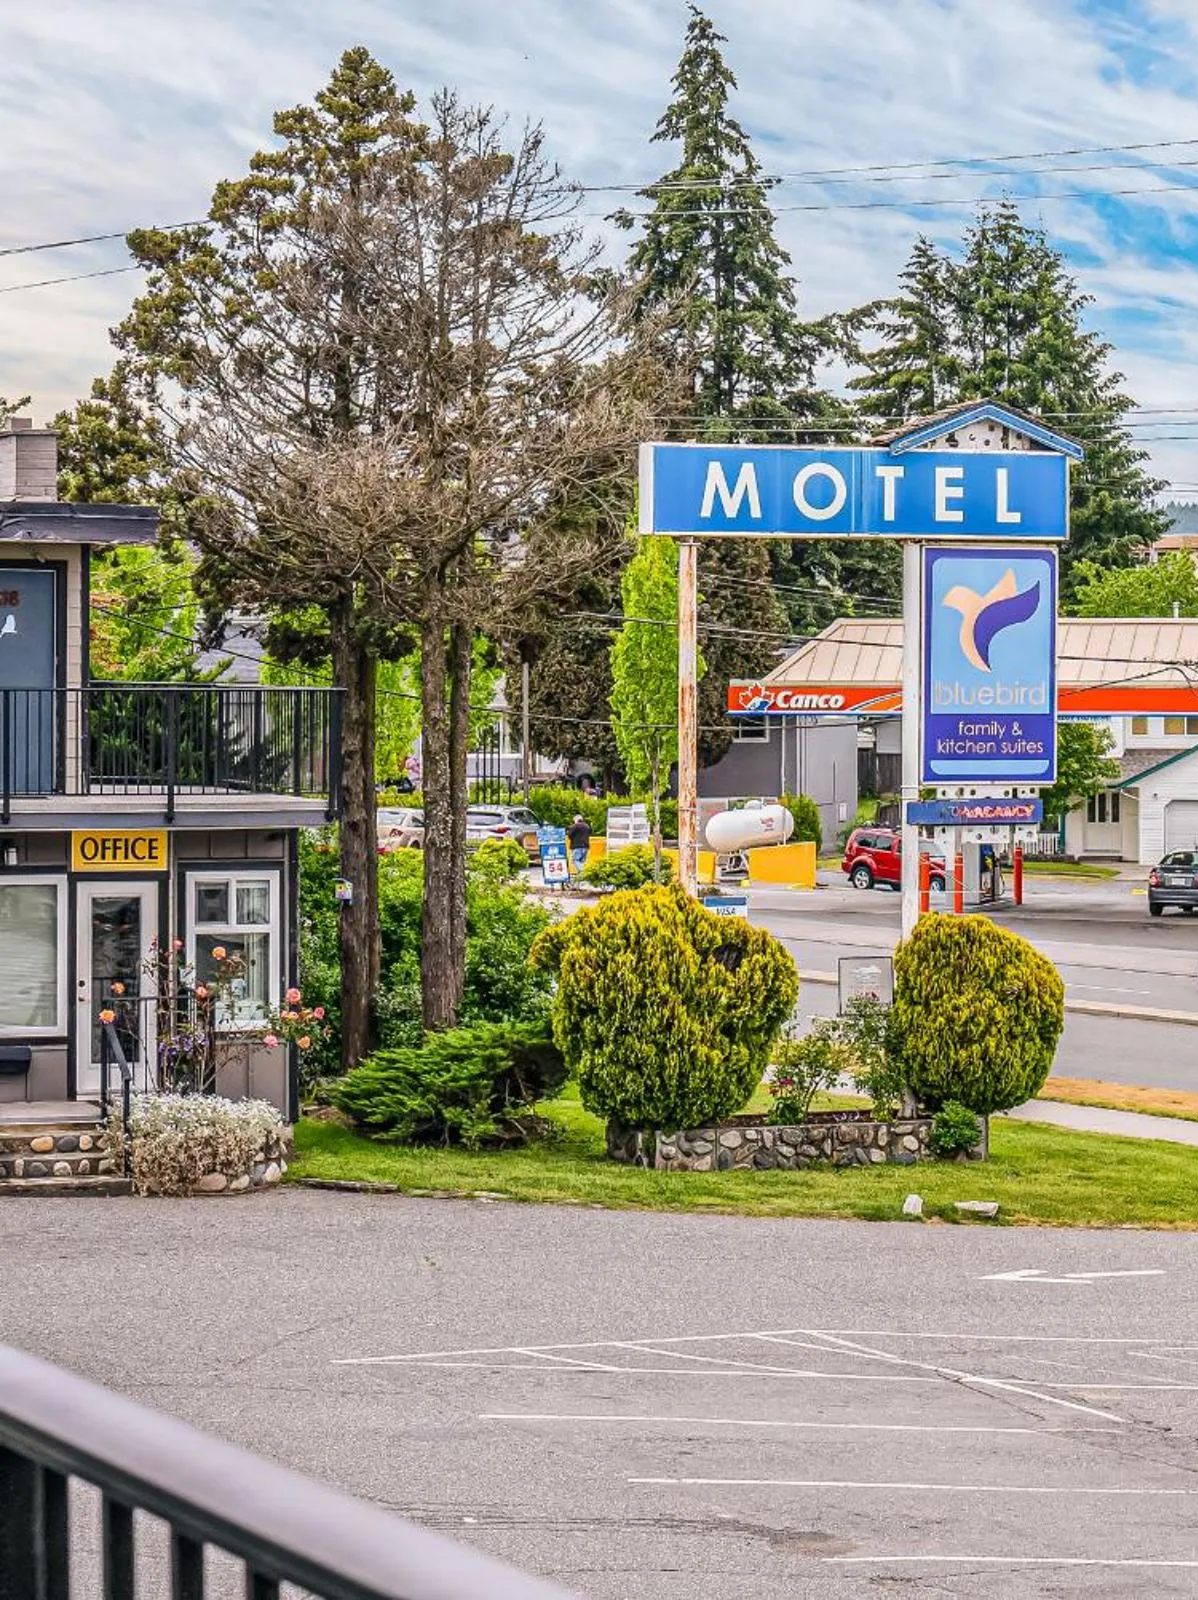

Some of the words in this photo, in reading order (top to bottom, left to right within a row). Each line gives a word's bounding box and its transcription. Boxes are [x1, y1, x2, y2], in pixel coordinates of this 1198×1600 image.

[700, 461, 1022, 524] MOTEL
[776, 690, 845, 709] Canco
[935, 680, 1045, 706] bluebird
[958, 721, 1006, 738] family
[1011, 721, 1023, 736] &
[937, 739, 997, 754] kitchen
[1001, 739, 1044, 754] suites
[80, 836, 159, 861] OFFICE
